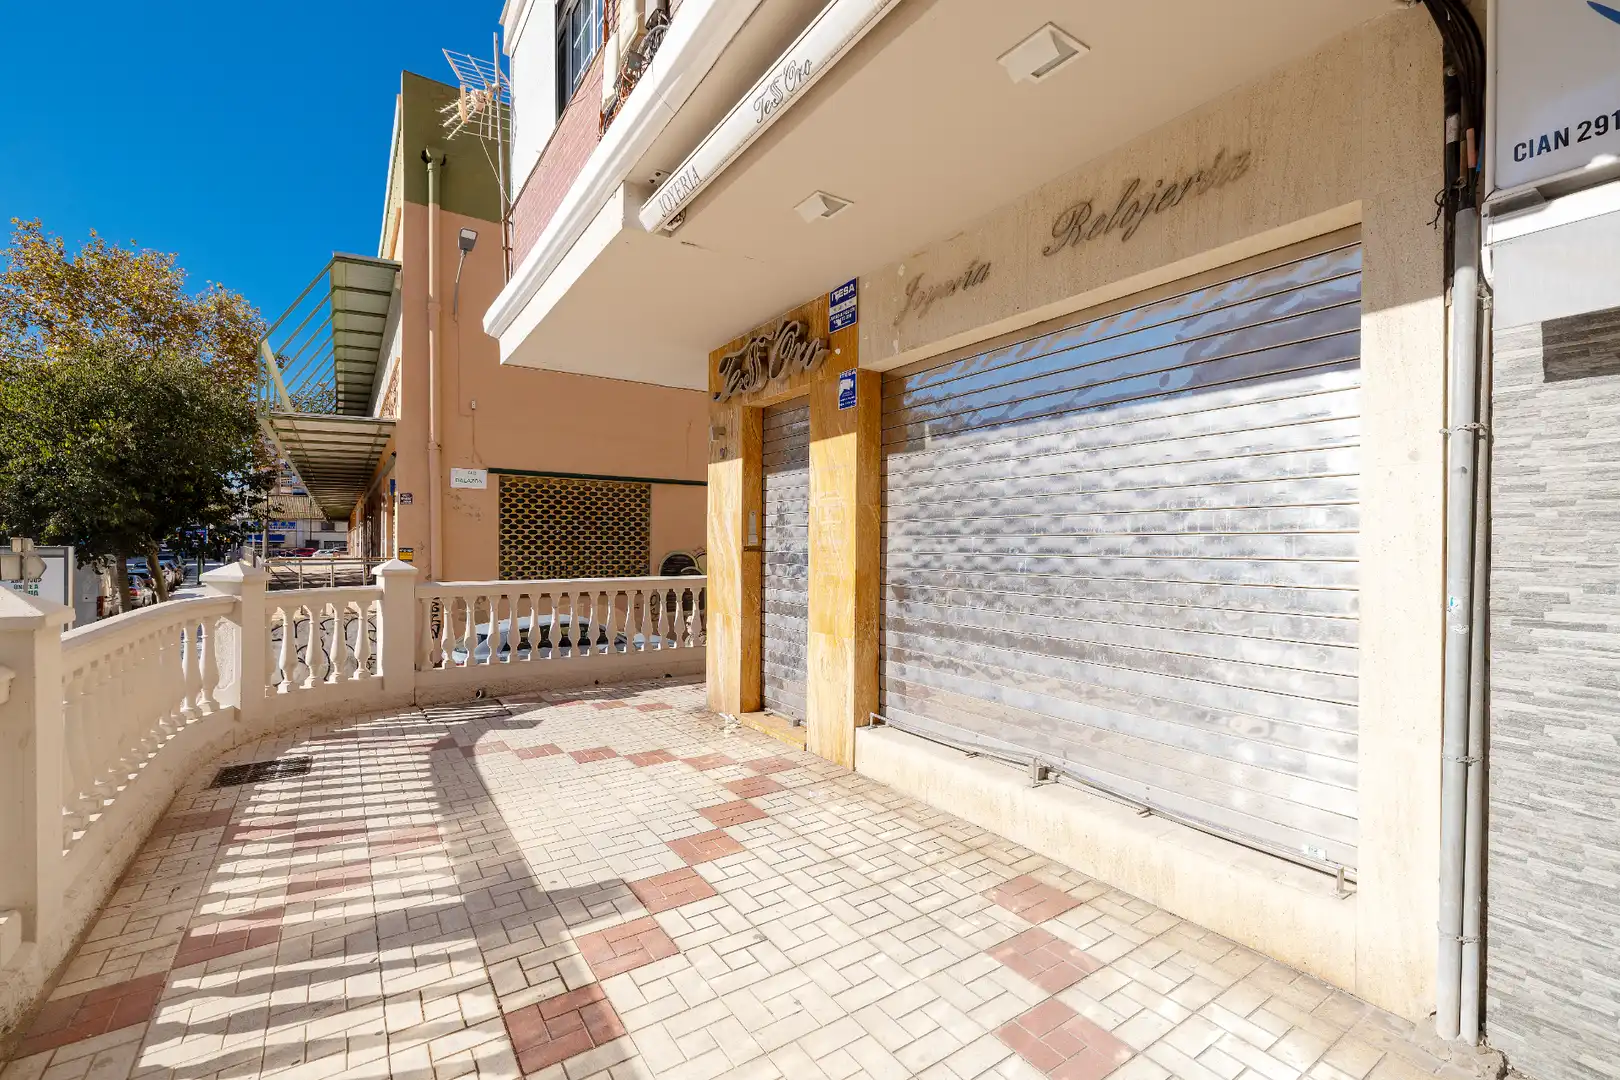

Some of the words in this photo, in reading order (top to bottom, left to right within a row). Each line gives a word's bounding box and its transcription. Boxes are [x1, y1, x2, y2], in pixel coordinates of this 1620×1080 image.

[1513, 127, 1570, 163] CIAN
[1576, 109, 1620, 143] 291
[659, 163, 702, 218] JOYERIA
